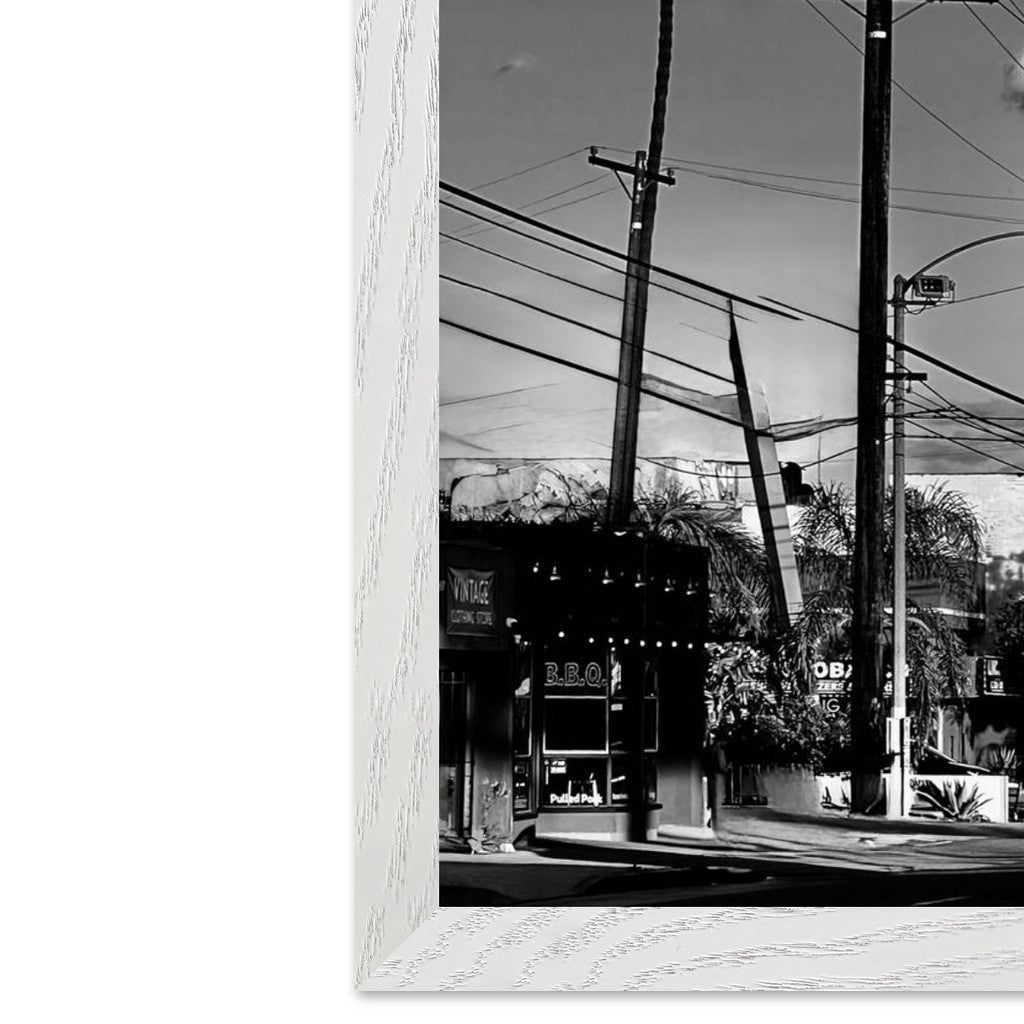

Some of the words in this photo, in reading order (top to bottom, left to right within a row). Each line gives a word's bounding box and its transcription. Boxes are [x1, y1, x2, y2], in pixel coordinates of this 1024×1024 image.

[453, 577, 490, 605] VINTAGE
[545, 662, 608, 687] B.B.Q.
[581, 793, 603, 804] Pok
